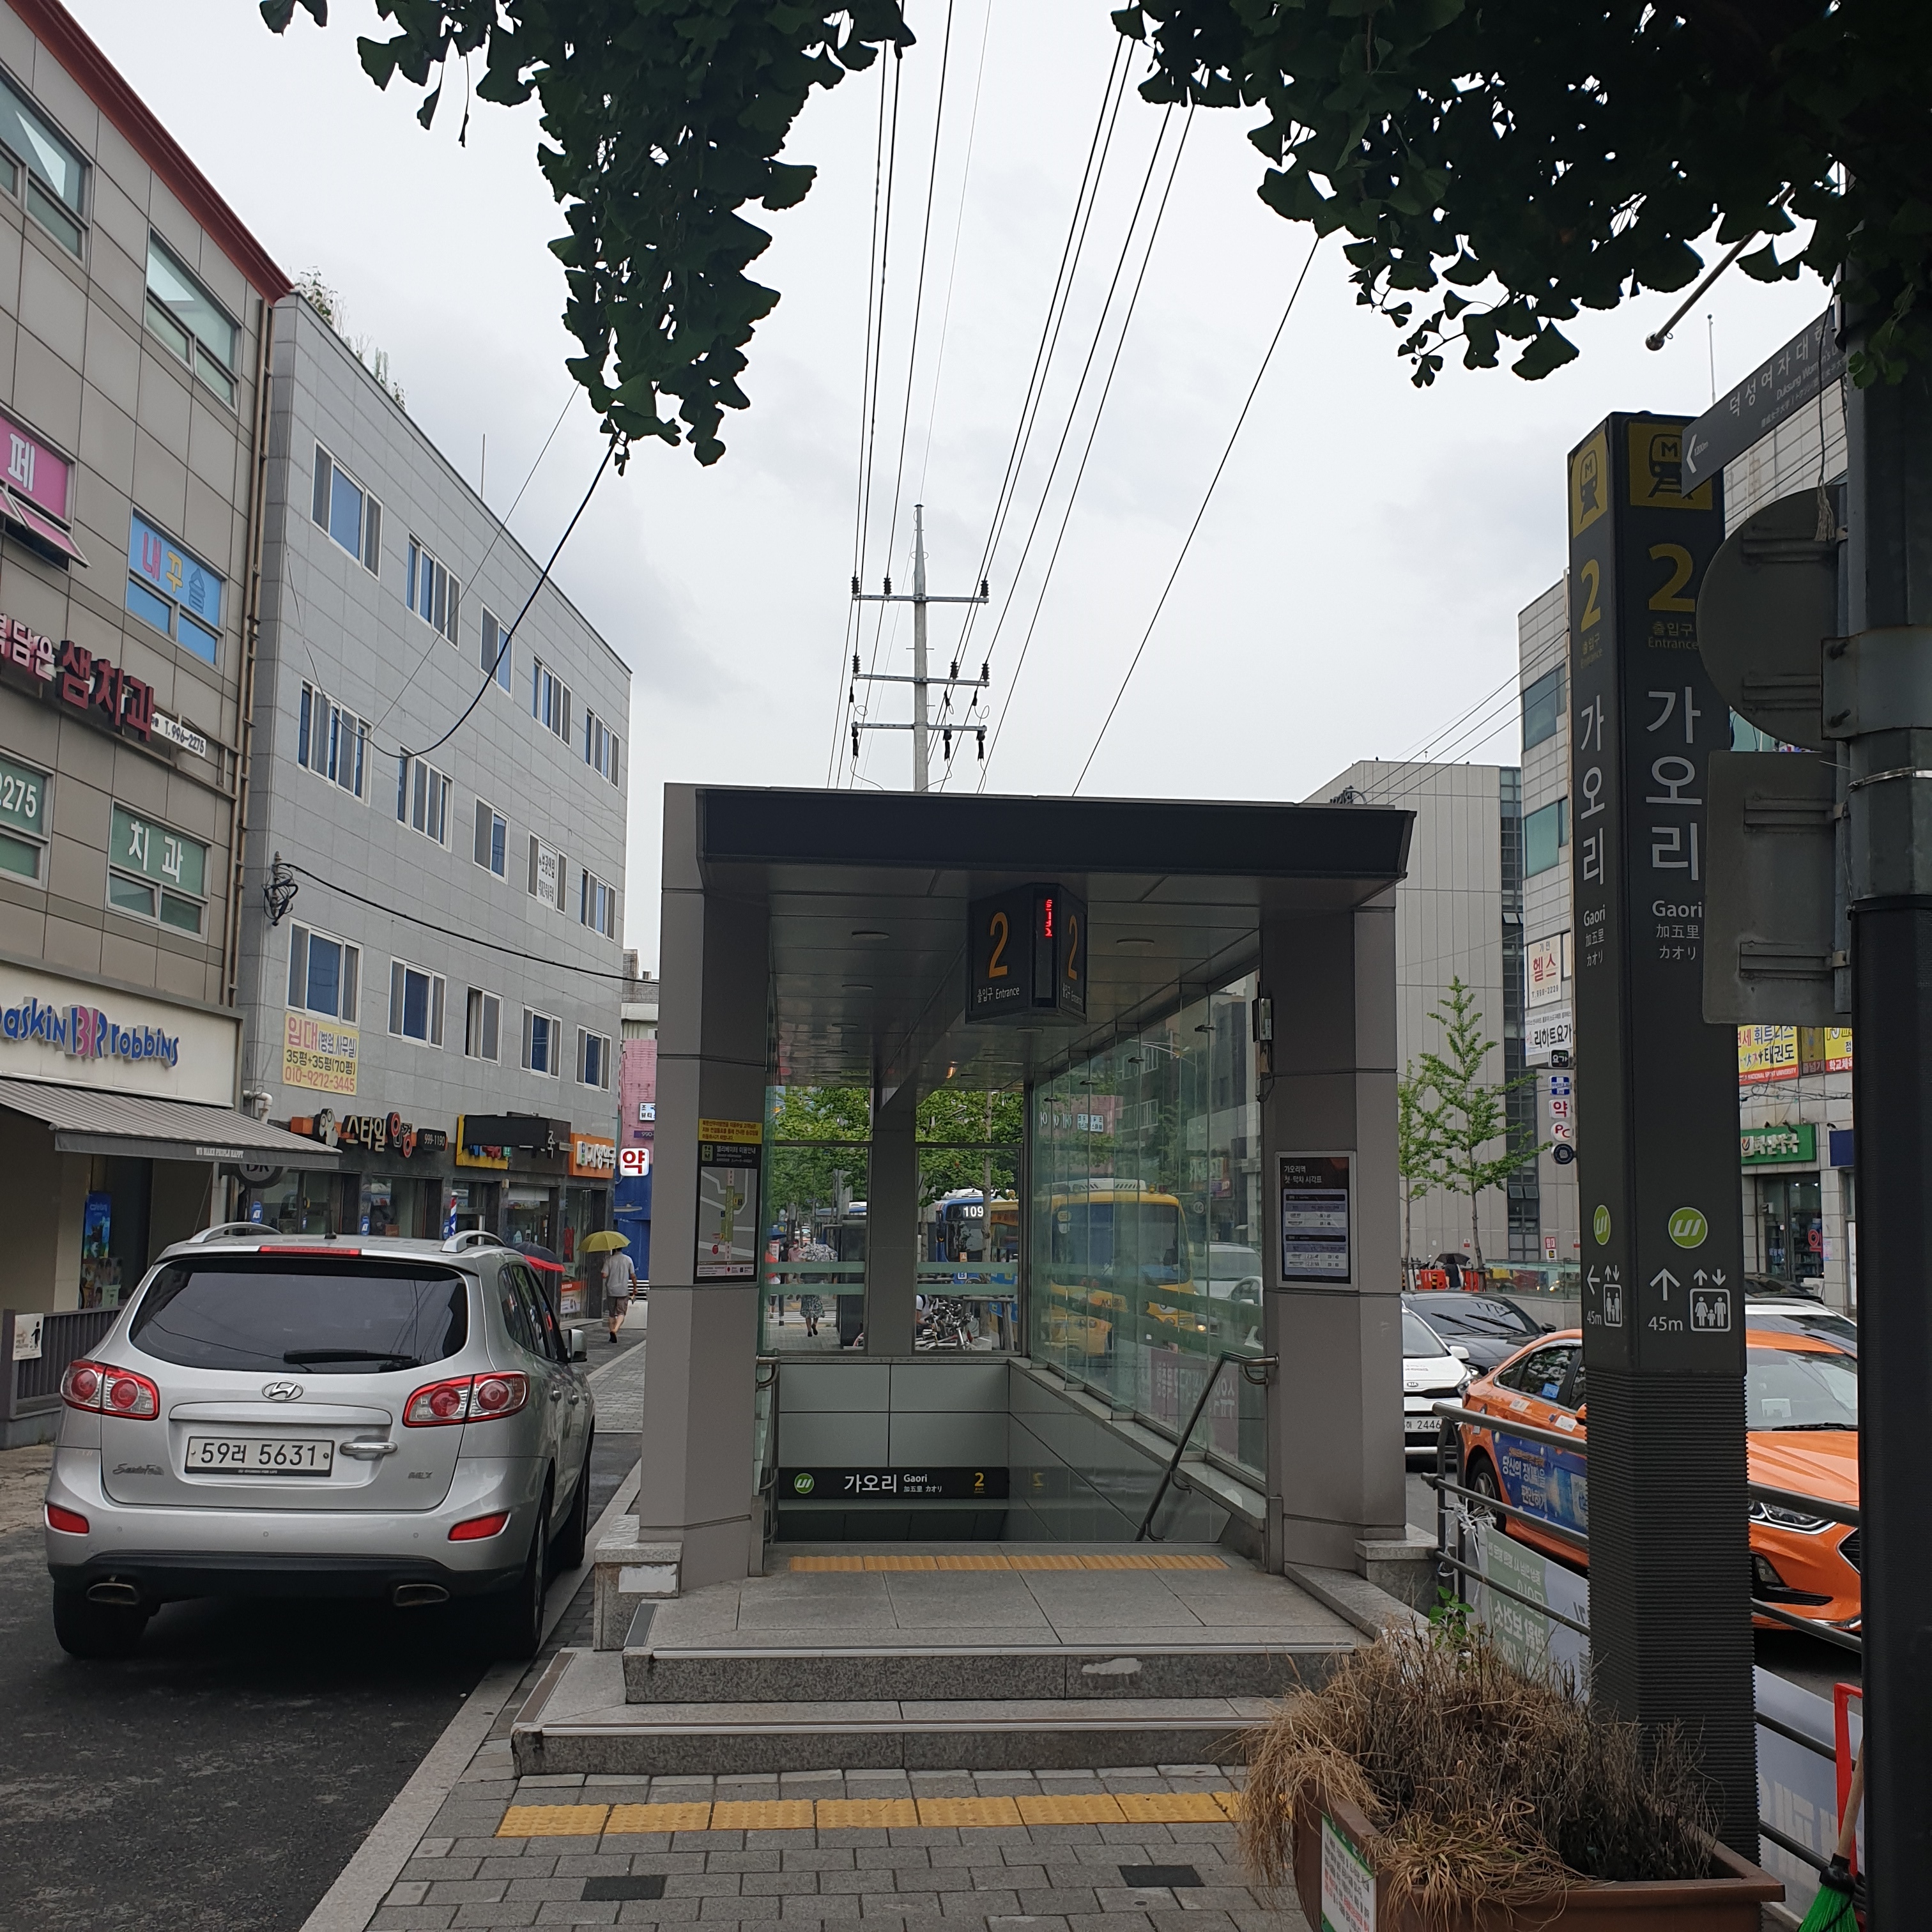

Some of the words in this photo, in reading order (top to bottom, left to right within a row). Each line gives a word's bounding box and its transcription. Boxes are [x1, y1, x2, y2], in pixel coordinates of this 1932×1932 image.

[1802, 349, 1831, 379] Womn's
[8, 433, 35, 492] 페
[1648, 542, 1696, 613] 2
[1581, 559, 1601, 632] 2
[1652, 621, 1694, 636] 출입구
[1648, 636, 1699, 651] Entrance
[61, 640, 156, 742] 샘치과
[1581, 694, 1605, 885] 가오리
[1646, 686, 1703, 882] 가오리
[128, 820, 184, 884] 치과
[1583, 904, 1606, 928] Gaori
[1652, 900, 1703, 919] Gaori
[1585, 928, 1604, 948] 加五里
[1656, 924, 1700, 940] 加五里
[988, 912, 1008, 978] 2
[1068, 914, 1077, 981] 2
[1659, 945, 1696, 960] カオリ
[1533, 953, 1556, 983] 헬스
[1586, 950, 1604, 967] カオリ
[977, 987, 993, 1003] 출입구
[996, 986, 1020, 1000] Entrance
[0, 997, 67, 1047] askin
[288, 1016, 318, 1051] 임대
[1552, 1054, 1568, 1063] 요가
[1765, 1043, 1795, 1064] 태권도
[285, 1066, 355, 1092] 010-9272-3445
[1553, 1101, 1568, 1117] 약
[346, 1115, 386, 1152] 스타일
[1554, 1124, 1570, 1138] PC
[622, 1150, 645, 1174] 약
[1284, 1165, 1306, 1174] 가오리역
[963, 1206, 984, 1217] 109
[1586, 1310, 1602, 1326] 45m
[1648, 1316, 1683, 1331] 45m
[1417, 1420, 1441, 1429] 2446
[201, 1442, 247, 1464] 59러
[258, 1444, 316, 1466] 5631
[1503, 1456, 1522, 1480] 당신의
[844, 1474, 897, 1493] 가오리
[903, 1473, 928, 1483] Gaori
[974, 1473, 985, 1487] 2
